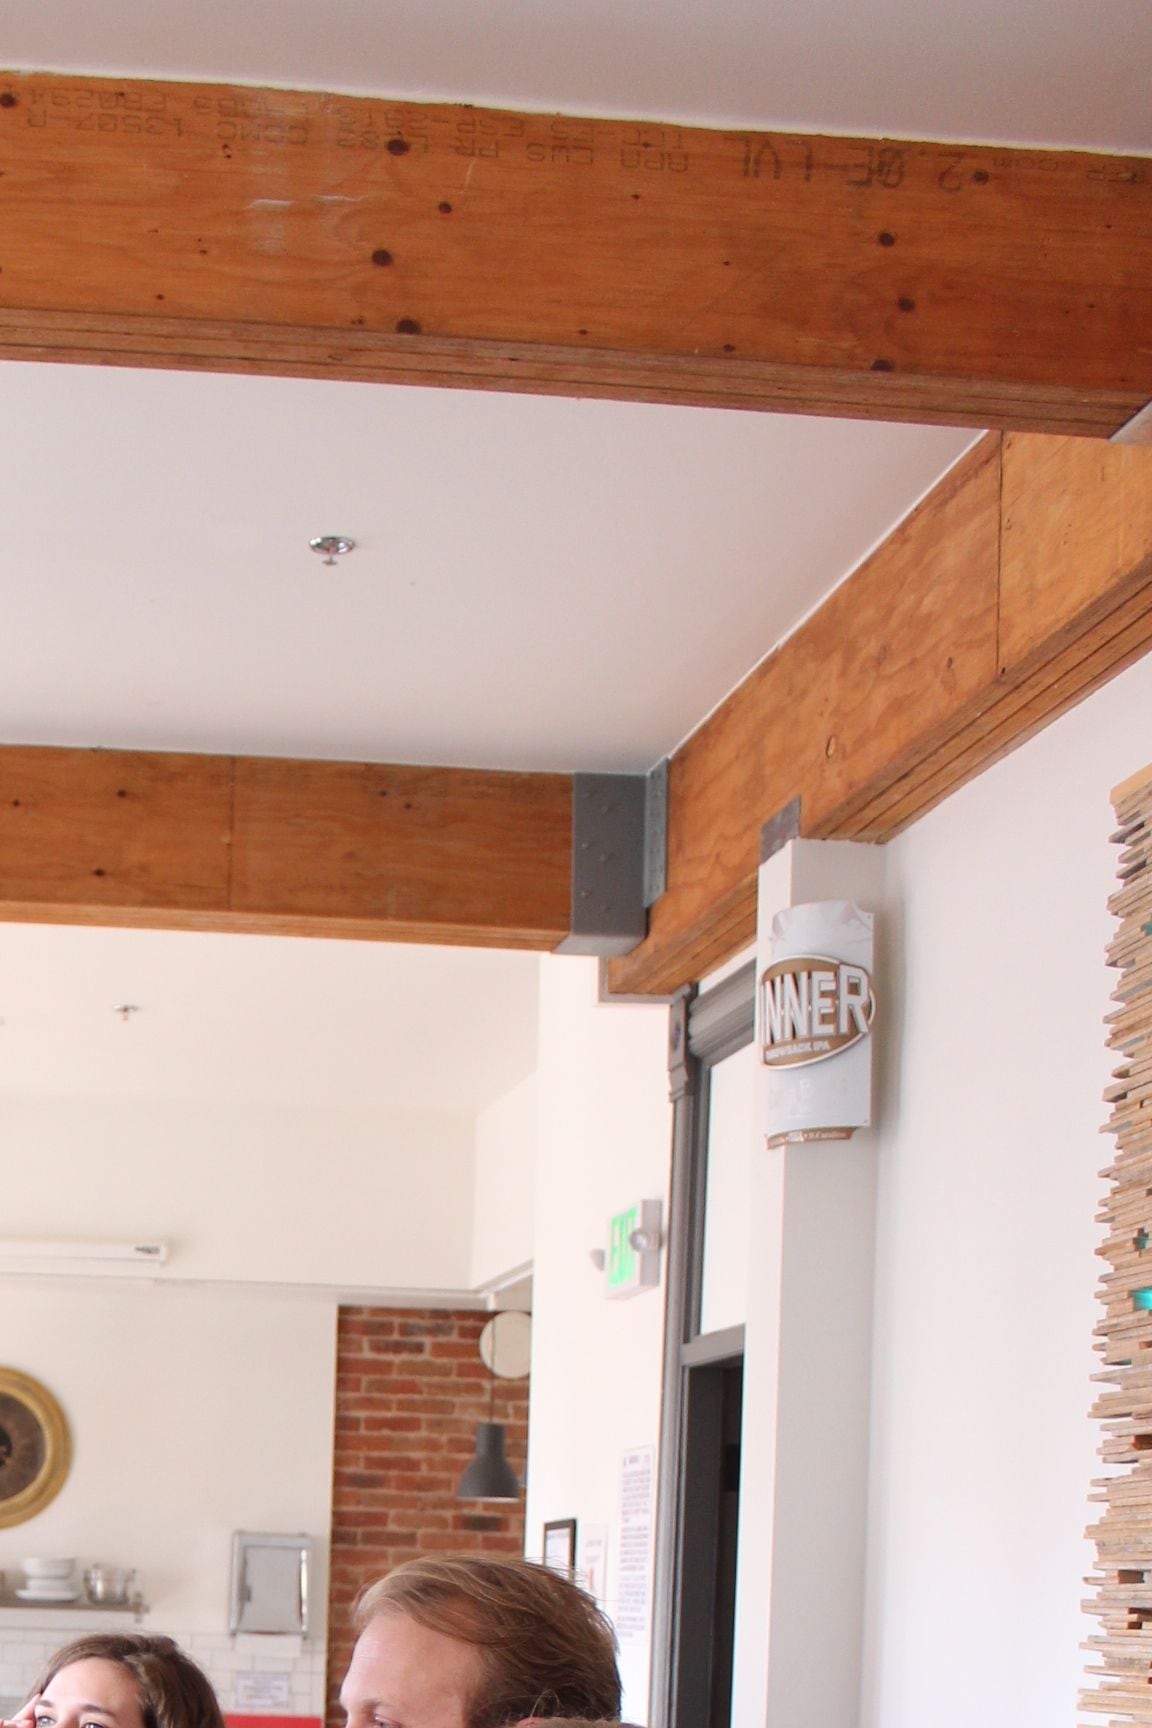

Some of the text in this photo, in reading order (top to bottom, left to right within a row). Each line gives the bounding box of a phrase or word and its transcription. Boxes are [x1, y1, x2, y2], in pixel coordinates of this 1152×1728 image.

[215, 118, 309, 148] CCMC
[335, 125, 500, 162] PR-L82
[524, 140, 594, 167] EWS
[619, 145, 689, 175] APA
[761, 964, 869, 1045] NNER
